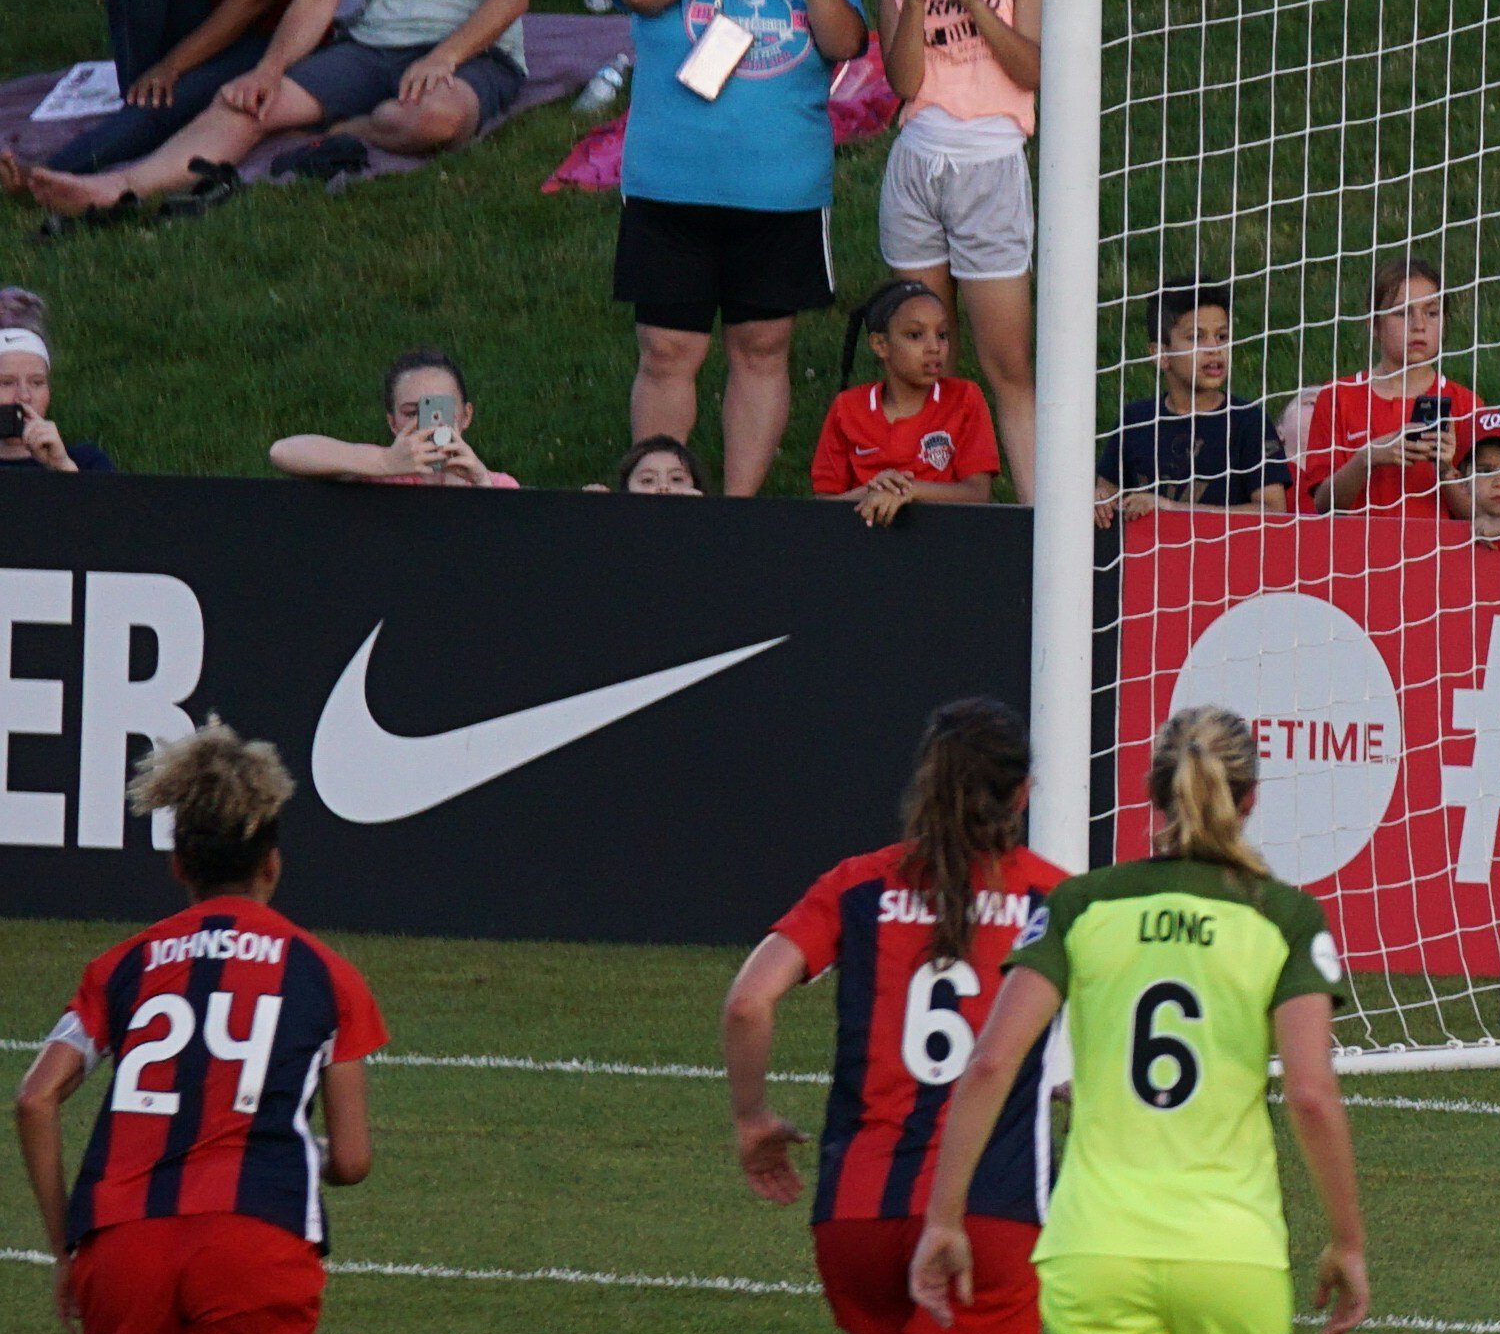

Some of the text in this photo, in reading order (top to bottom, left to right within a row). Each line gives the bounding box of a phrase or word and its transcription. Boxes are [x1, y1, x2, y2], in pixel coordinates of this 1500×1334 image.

[0, 569, 204, 851] ER
[1252, 719, 1384, 763] ETIME
[145, 929, 284, 971] JOHNSON
[877, 889, 1031, 928] SULVAN
[1139, 909, 1217, 946] LONG
[111, 992, 283, 1115] 24
[902, 958, 980, 1086] 6
[1131, 980, 1203, 1109] 6
